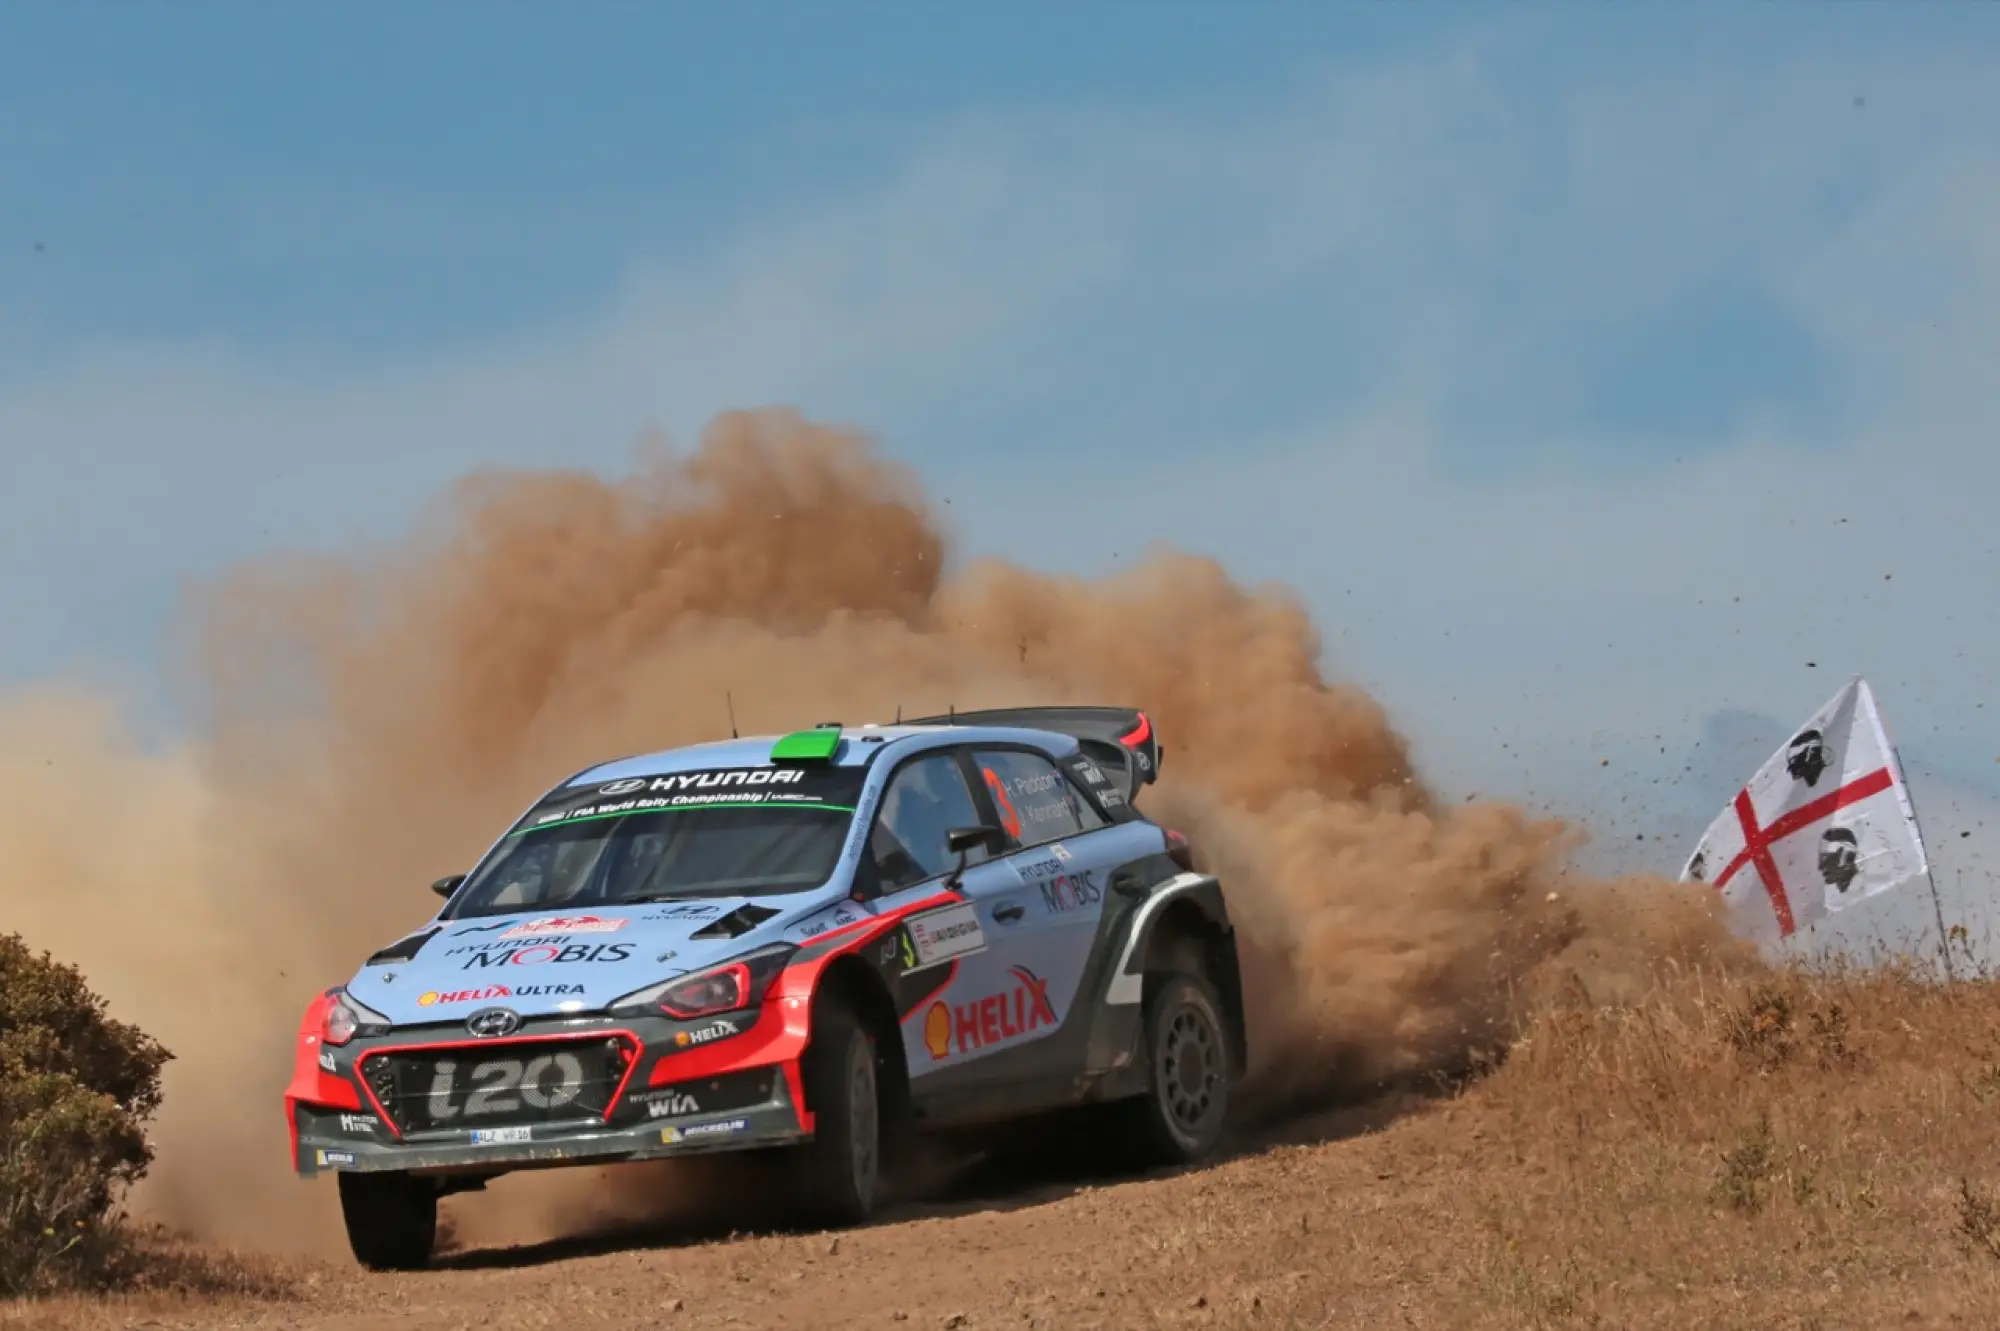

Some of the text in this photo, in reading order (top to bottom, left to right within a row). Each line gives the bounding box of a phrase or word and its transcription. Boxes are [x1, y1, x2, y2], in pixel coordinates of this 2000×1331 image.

[649, 770, 805, 791] HYUNDAI
[597, 800, 636, 813] World
[637, 798, 670, 808] Rally
[671, 792, 764, 805] Championship
[1040, 869, 1101, 914] MOBIS
[444, 934, 573, 957] HYUNDAI
[462, 943, 637, 971] MOBIS
[438, 983, 586, 1004] HELIX ULTRA
[954, 964, 1060, 1053] HELIX
[689, 1020, 740, 1044] HELIX
